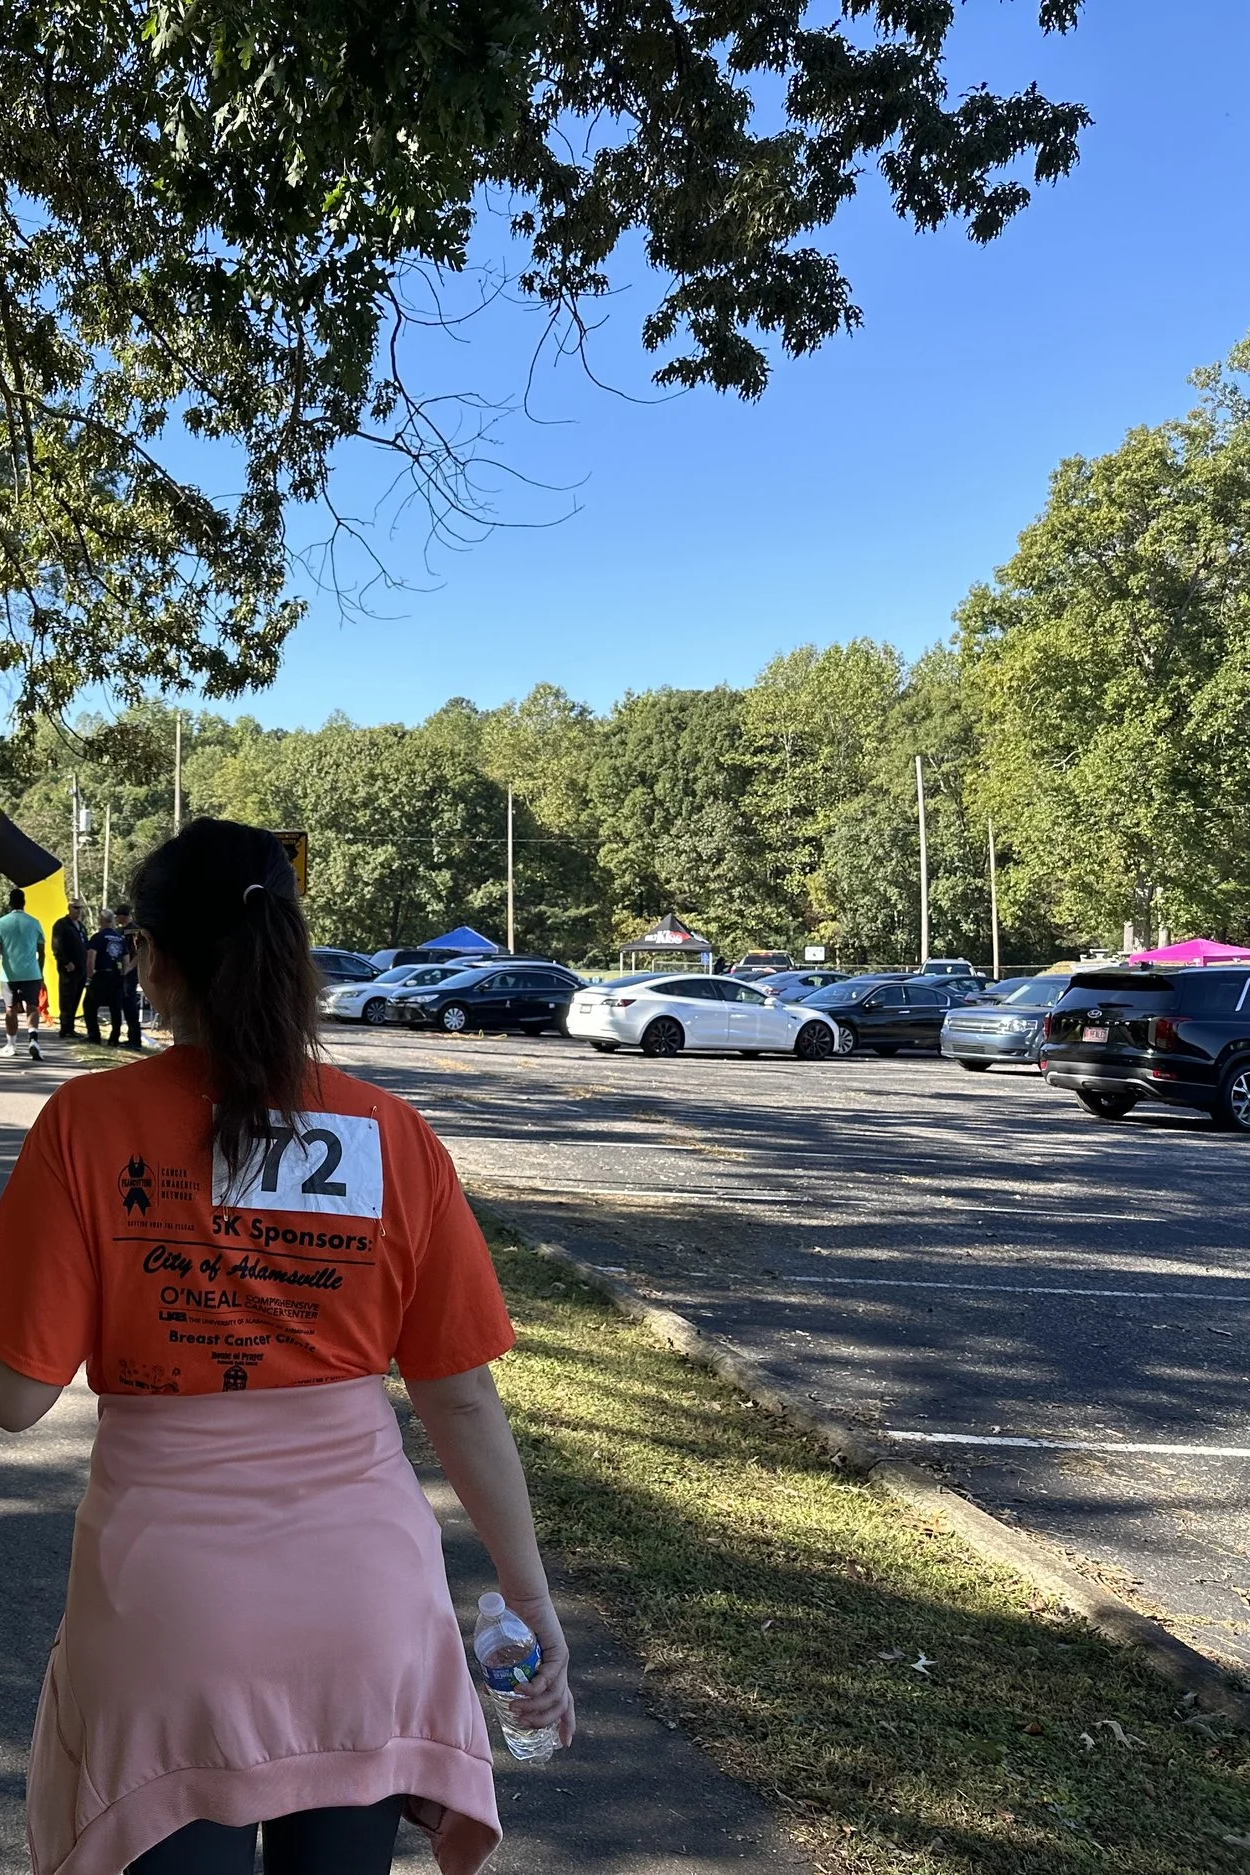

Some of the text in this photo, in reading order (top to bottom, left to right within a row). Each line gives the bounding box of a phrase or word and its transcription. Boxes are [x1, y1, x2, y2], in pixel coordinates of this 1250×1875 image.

[250, 1126, 347, 1197] 72
[212, 1215, 373, 1252] 5K Sponsors:
[143, 1244, 344, 1291] City of Adamsville
[160, 1285, 242, 1309] O'NEAL
[245, 1301, 284, 1317] CANCER
[168, 1330, 220, 1345] Breast
[224, 1333, 271, 1347] Cancer
